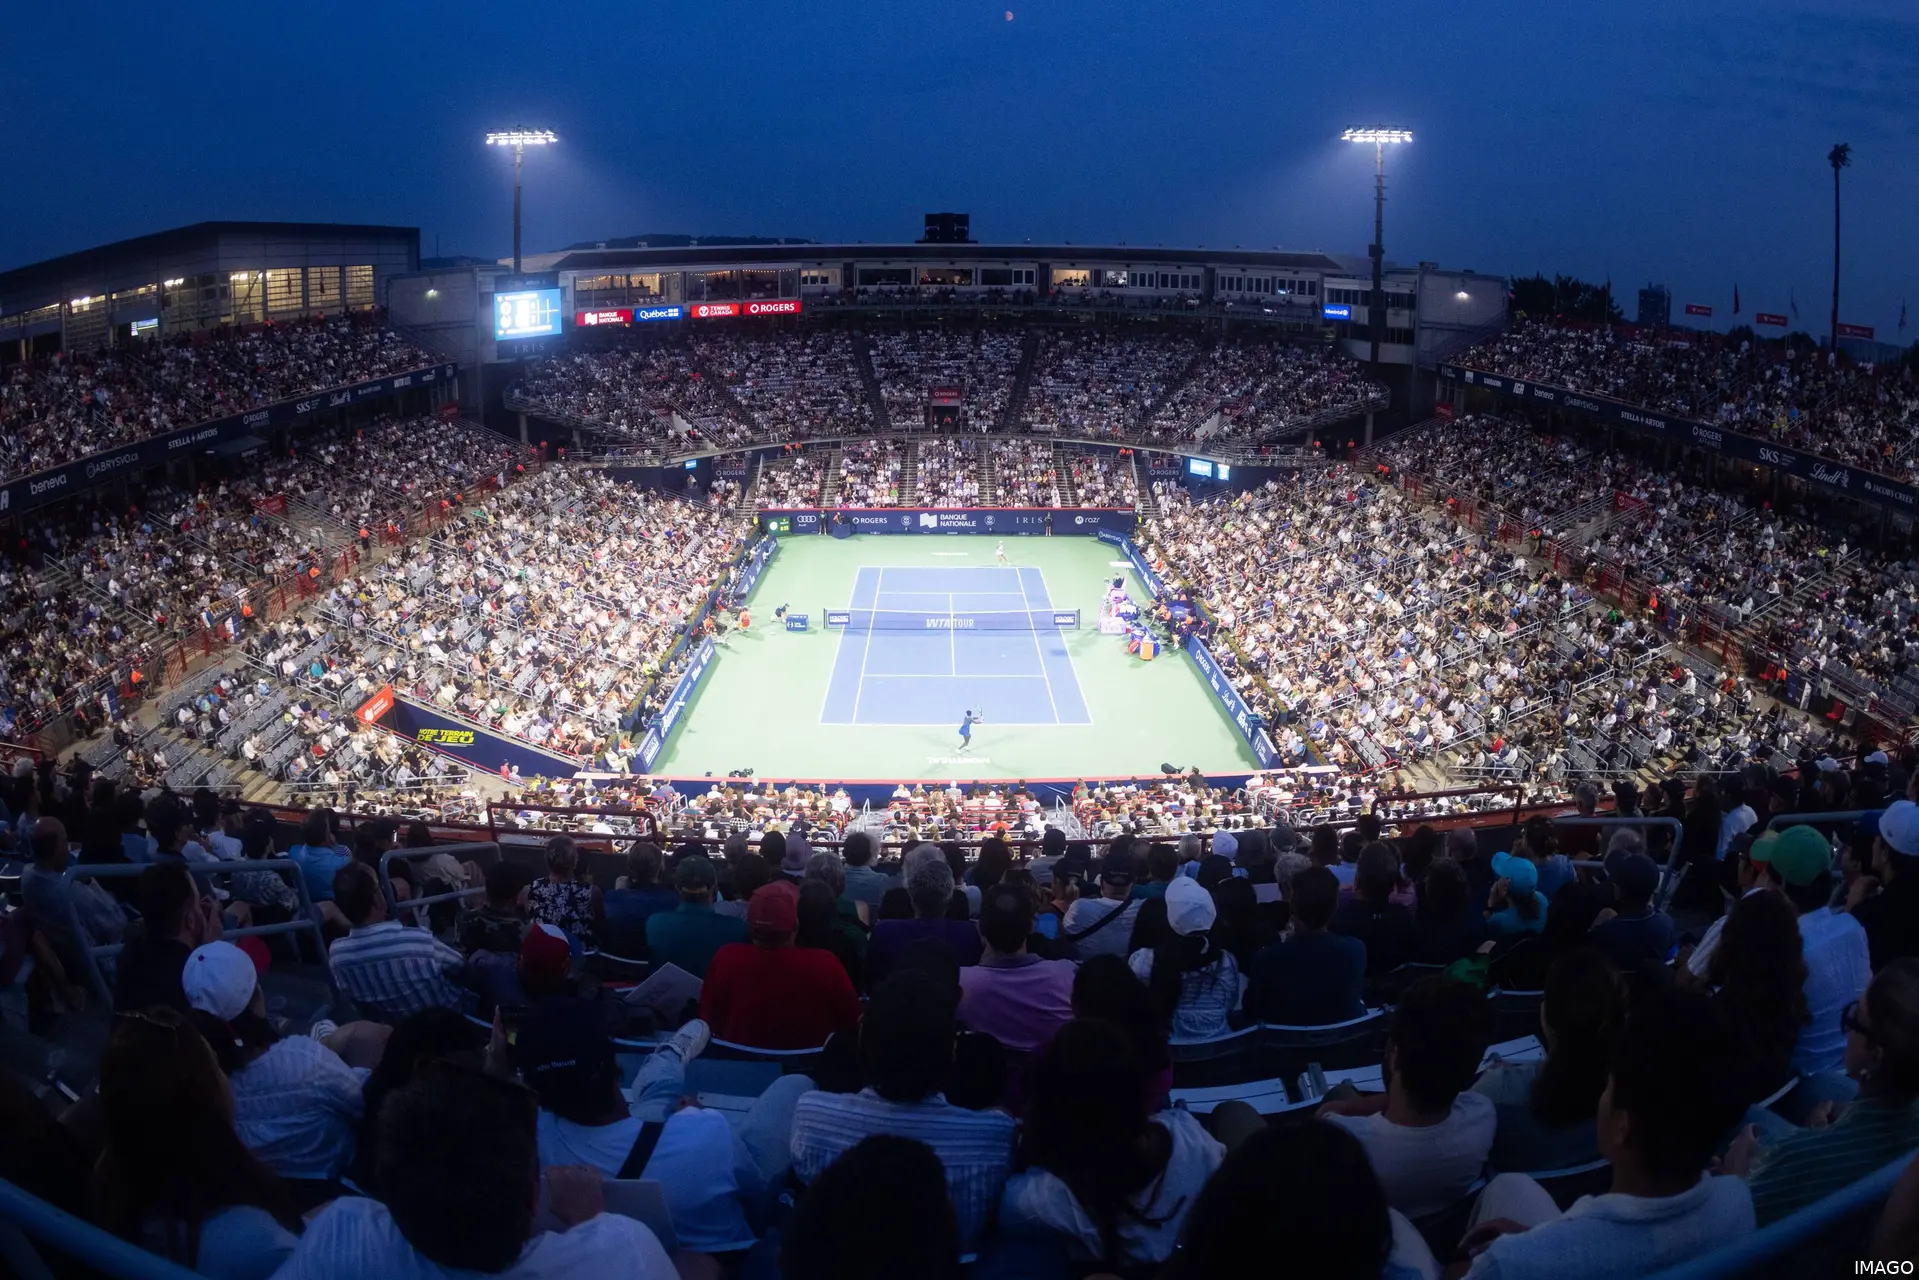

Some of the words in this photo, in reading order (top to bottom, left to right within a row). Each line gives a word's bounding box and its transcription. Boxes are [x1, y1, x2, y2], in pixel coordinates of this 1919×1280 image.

[640, 308, 668, 320] Québec
[760, 304, 794, 312] ROGERS
[514, 343, 545, 354] IRIS
[1534, 387, 1554, 400] beneva
[296, 401, 310, 414] SKS
[250, 410, 268, 422] ROGERS
[1620, 411, 1640, 422] STELLA
[1645, 418, 1666, 428] ARTOIS
[168, 438, 190, 450] STELLA
[196, 428, 218, 440] ARTOIS
[1699, 428, 1722, 442] ROGERS
[94, 452, 139, 473] ABRYSVO.ca
[1758, 448, 1779, 464] SKS
[30, 474, 67, 495] beneva
[1895, 492, 1914, 504] CREEK
[926, 618, 950, 627] WTA
[954, 619, 974, 627] TOUR
[434, 735, 474, 744] JEU
